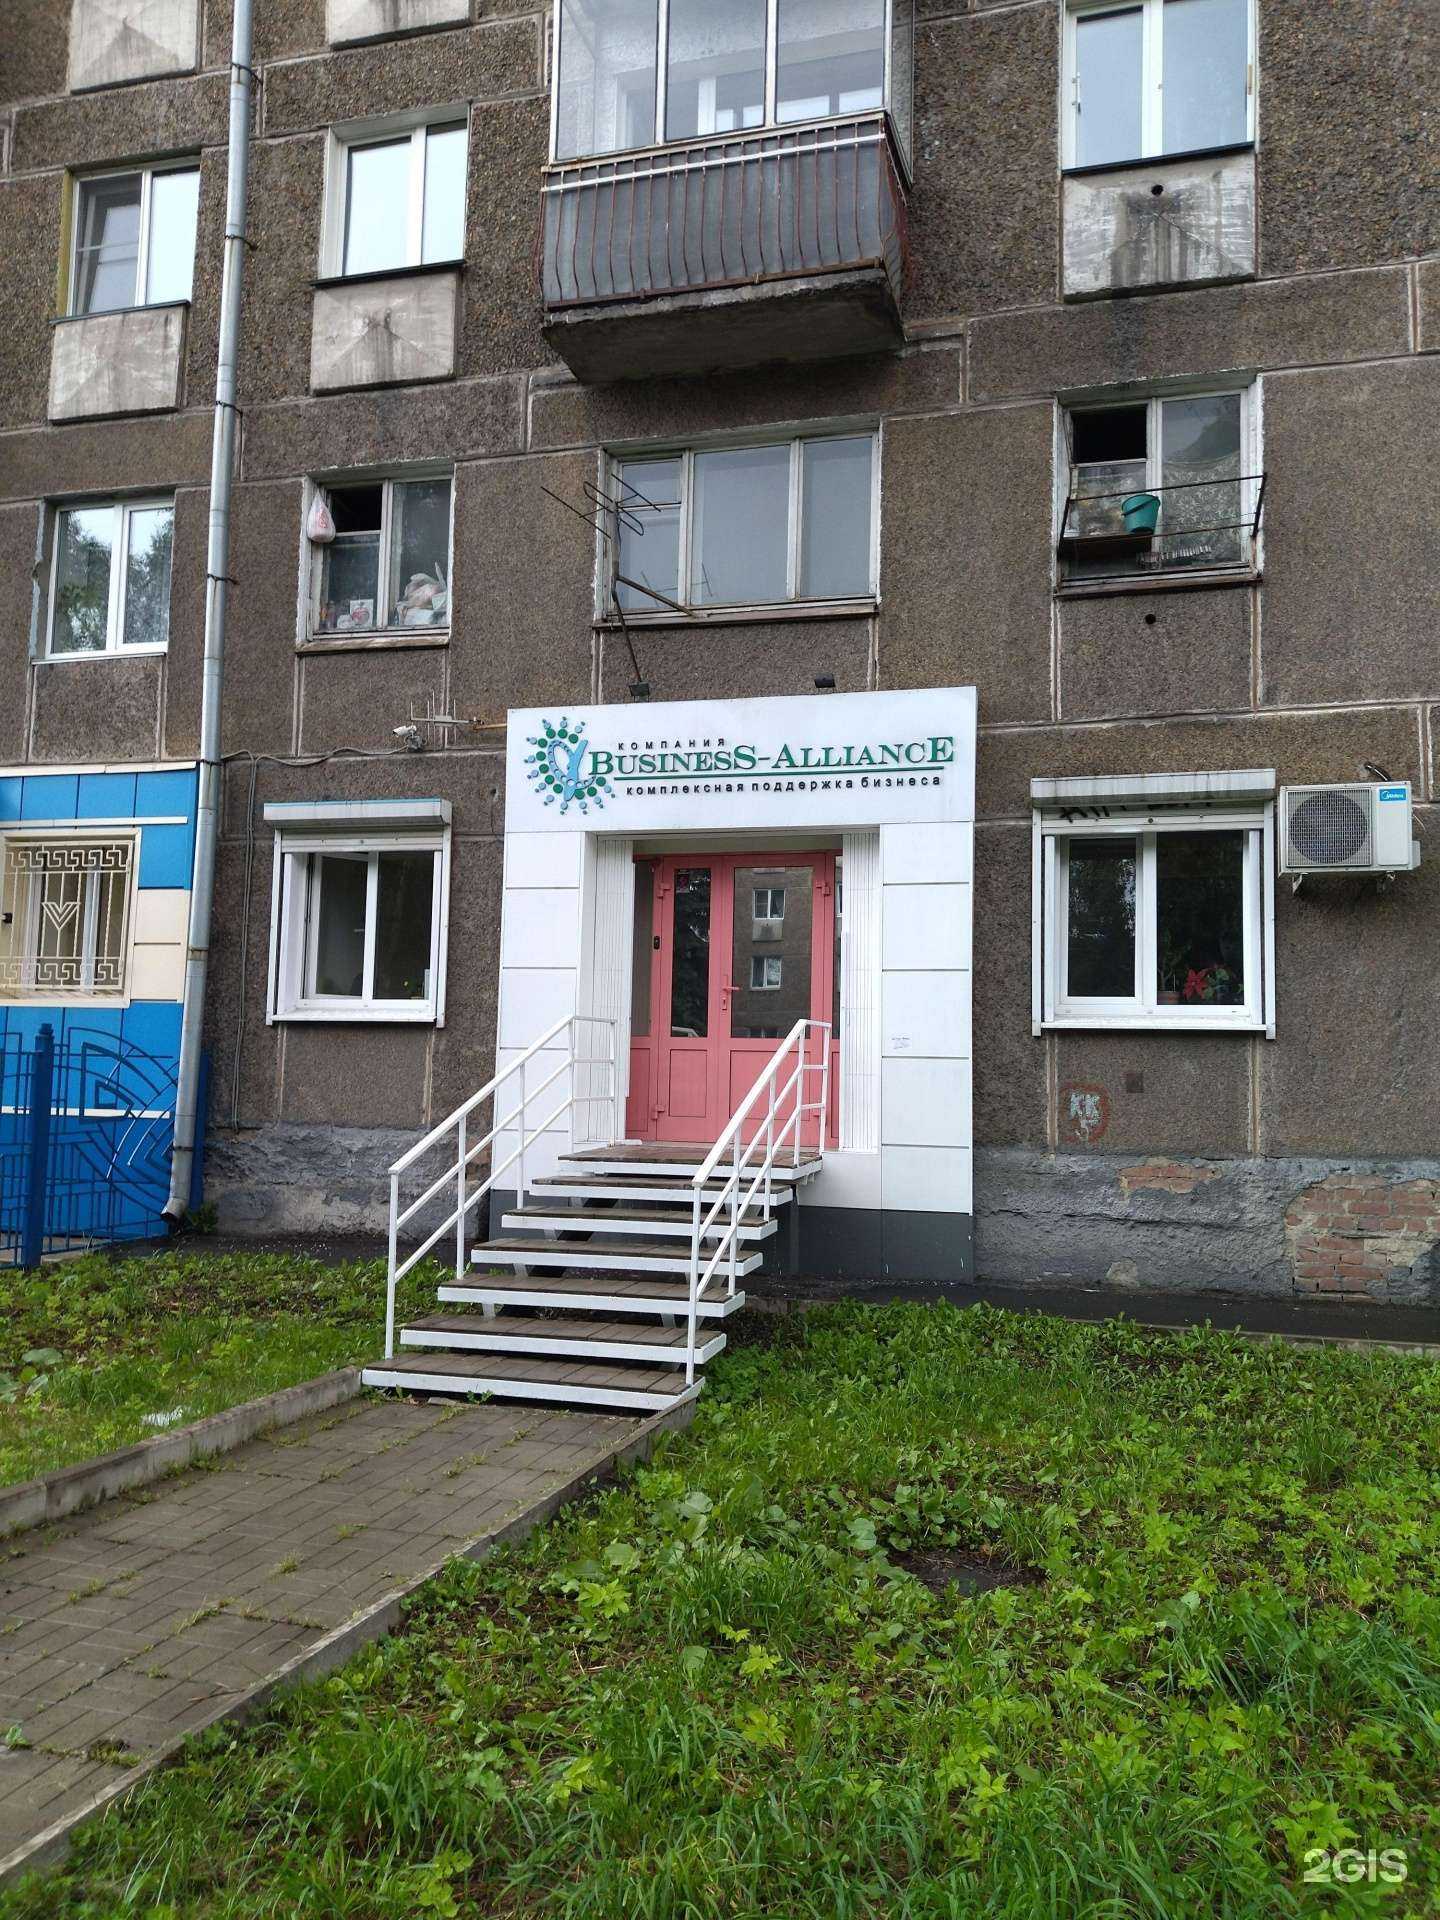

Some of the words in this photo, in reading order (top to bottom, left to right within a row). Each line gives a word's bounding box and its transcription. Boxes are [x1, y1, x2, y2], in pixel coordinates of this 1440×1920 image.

[626, 782, 744, 796] комплексная
[751, 778, 854, 793] поддержка
[861, 775, 941, 789] бизнеса
